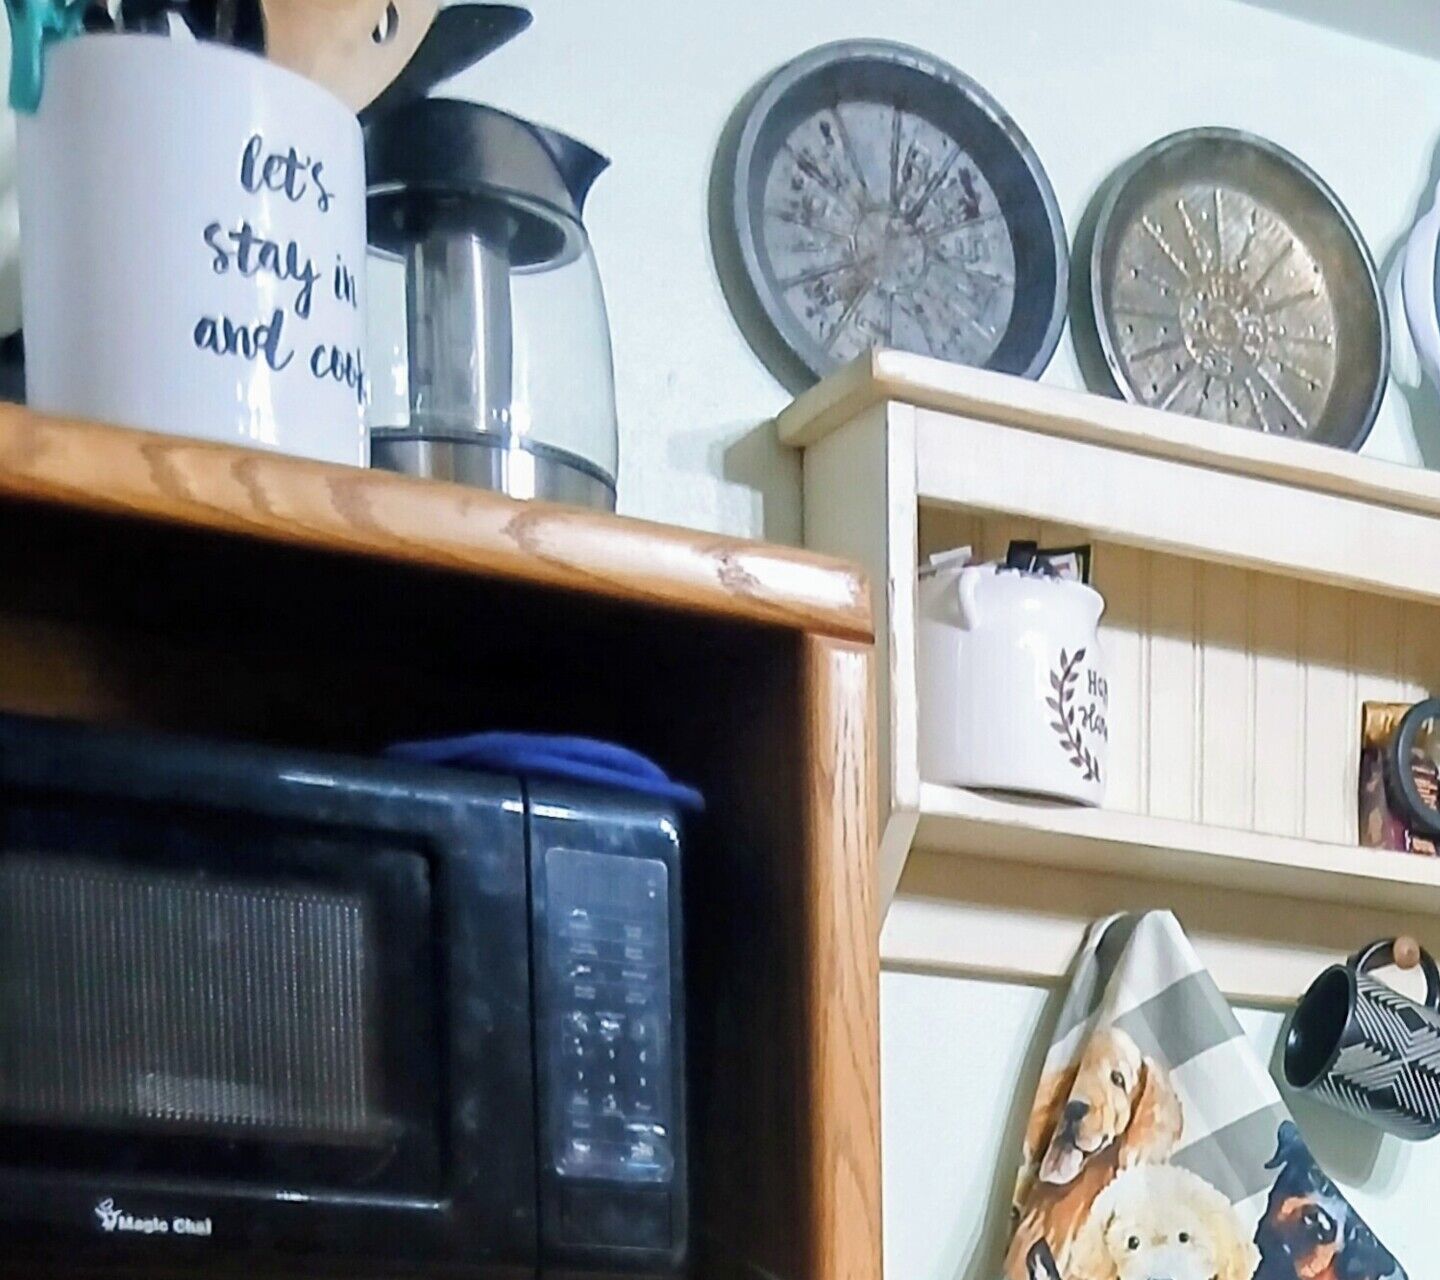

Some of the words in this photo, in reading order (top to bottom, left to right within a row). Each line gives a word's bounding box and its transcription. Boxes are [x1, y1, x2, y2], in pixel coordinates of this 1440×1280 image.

[240, 133, 336, 213] let's
[202, 220, 322, 320] stay
[193, 308, 295, 372] and
